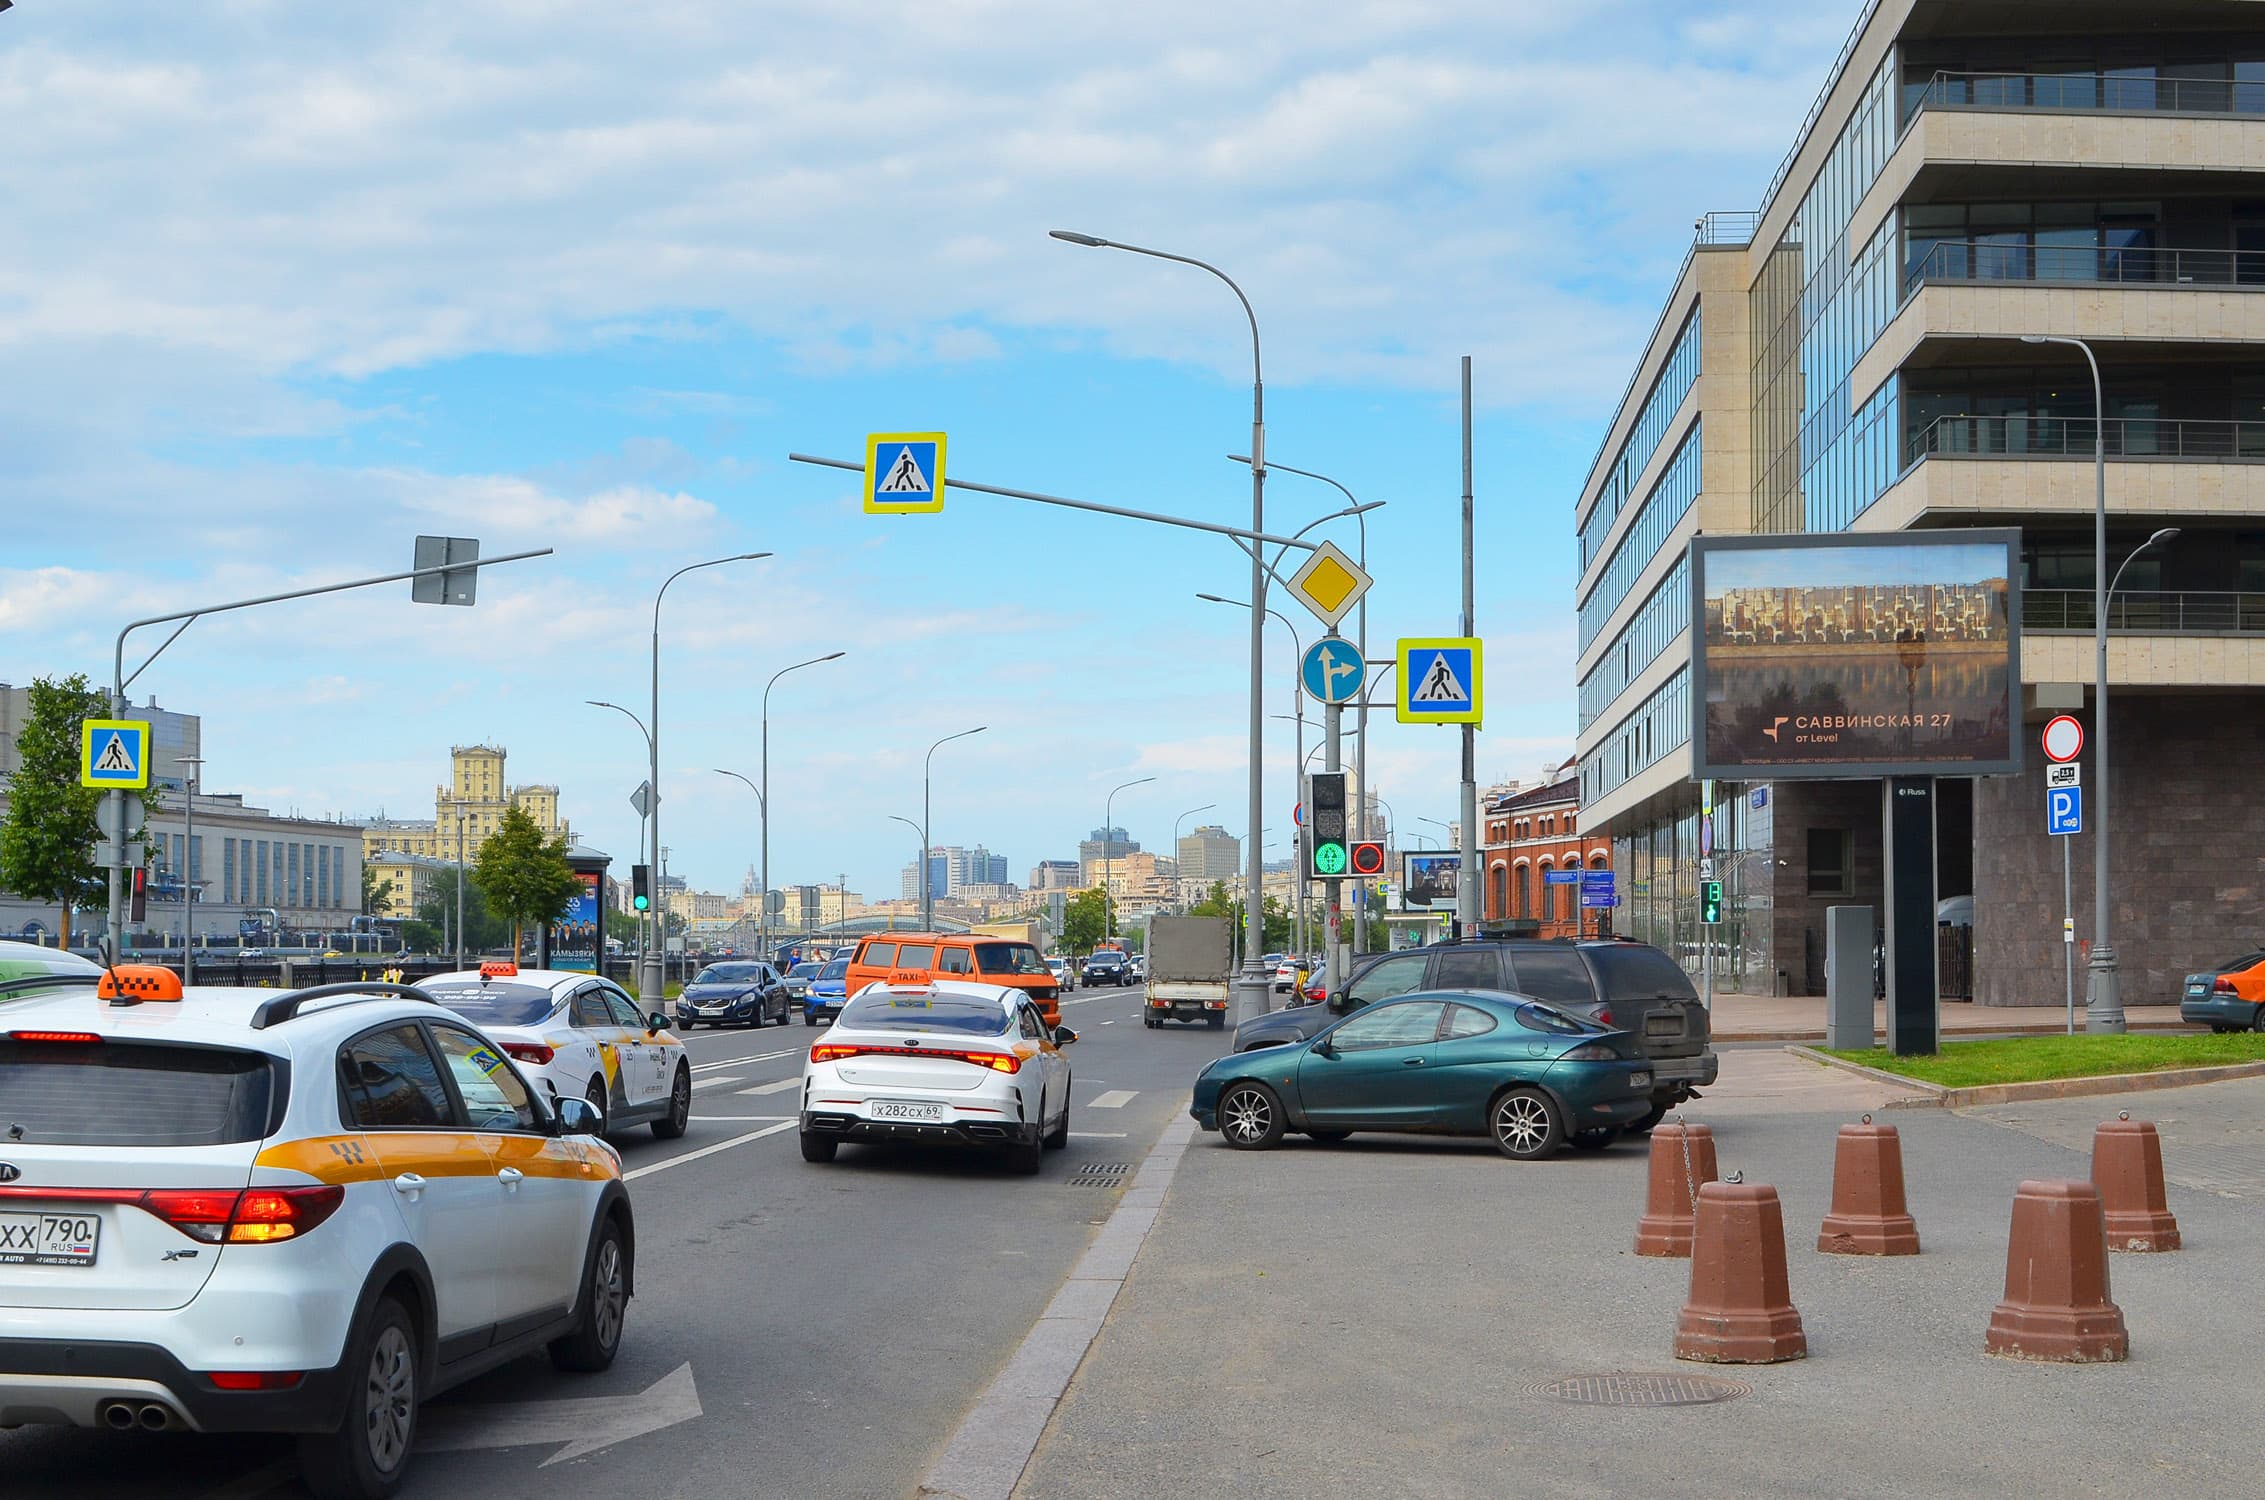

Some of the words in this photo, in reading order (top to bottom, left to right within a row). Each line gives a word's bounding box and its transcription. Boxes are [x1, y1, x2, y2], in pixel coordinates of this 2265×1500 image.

[1795, 715, 1924, 729] САВВИНСКАЯ
[1930, 714, 1951, 727] 27
[1795, 735, 1808, 743] от
[1810, 733, 1839, 743] Level
[2053, 792, 2072, 829] P
[550, 950, 595, 958] КАМЫЗЯКИ
[898, 973, 918, 981] TAXI
[44, 1218, 88, 1243] 790
[51, 1243, 73, 1253] RUS
[5, 1255, 25, 1263] AUTO
